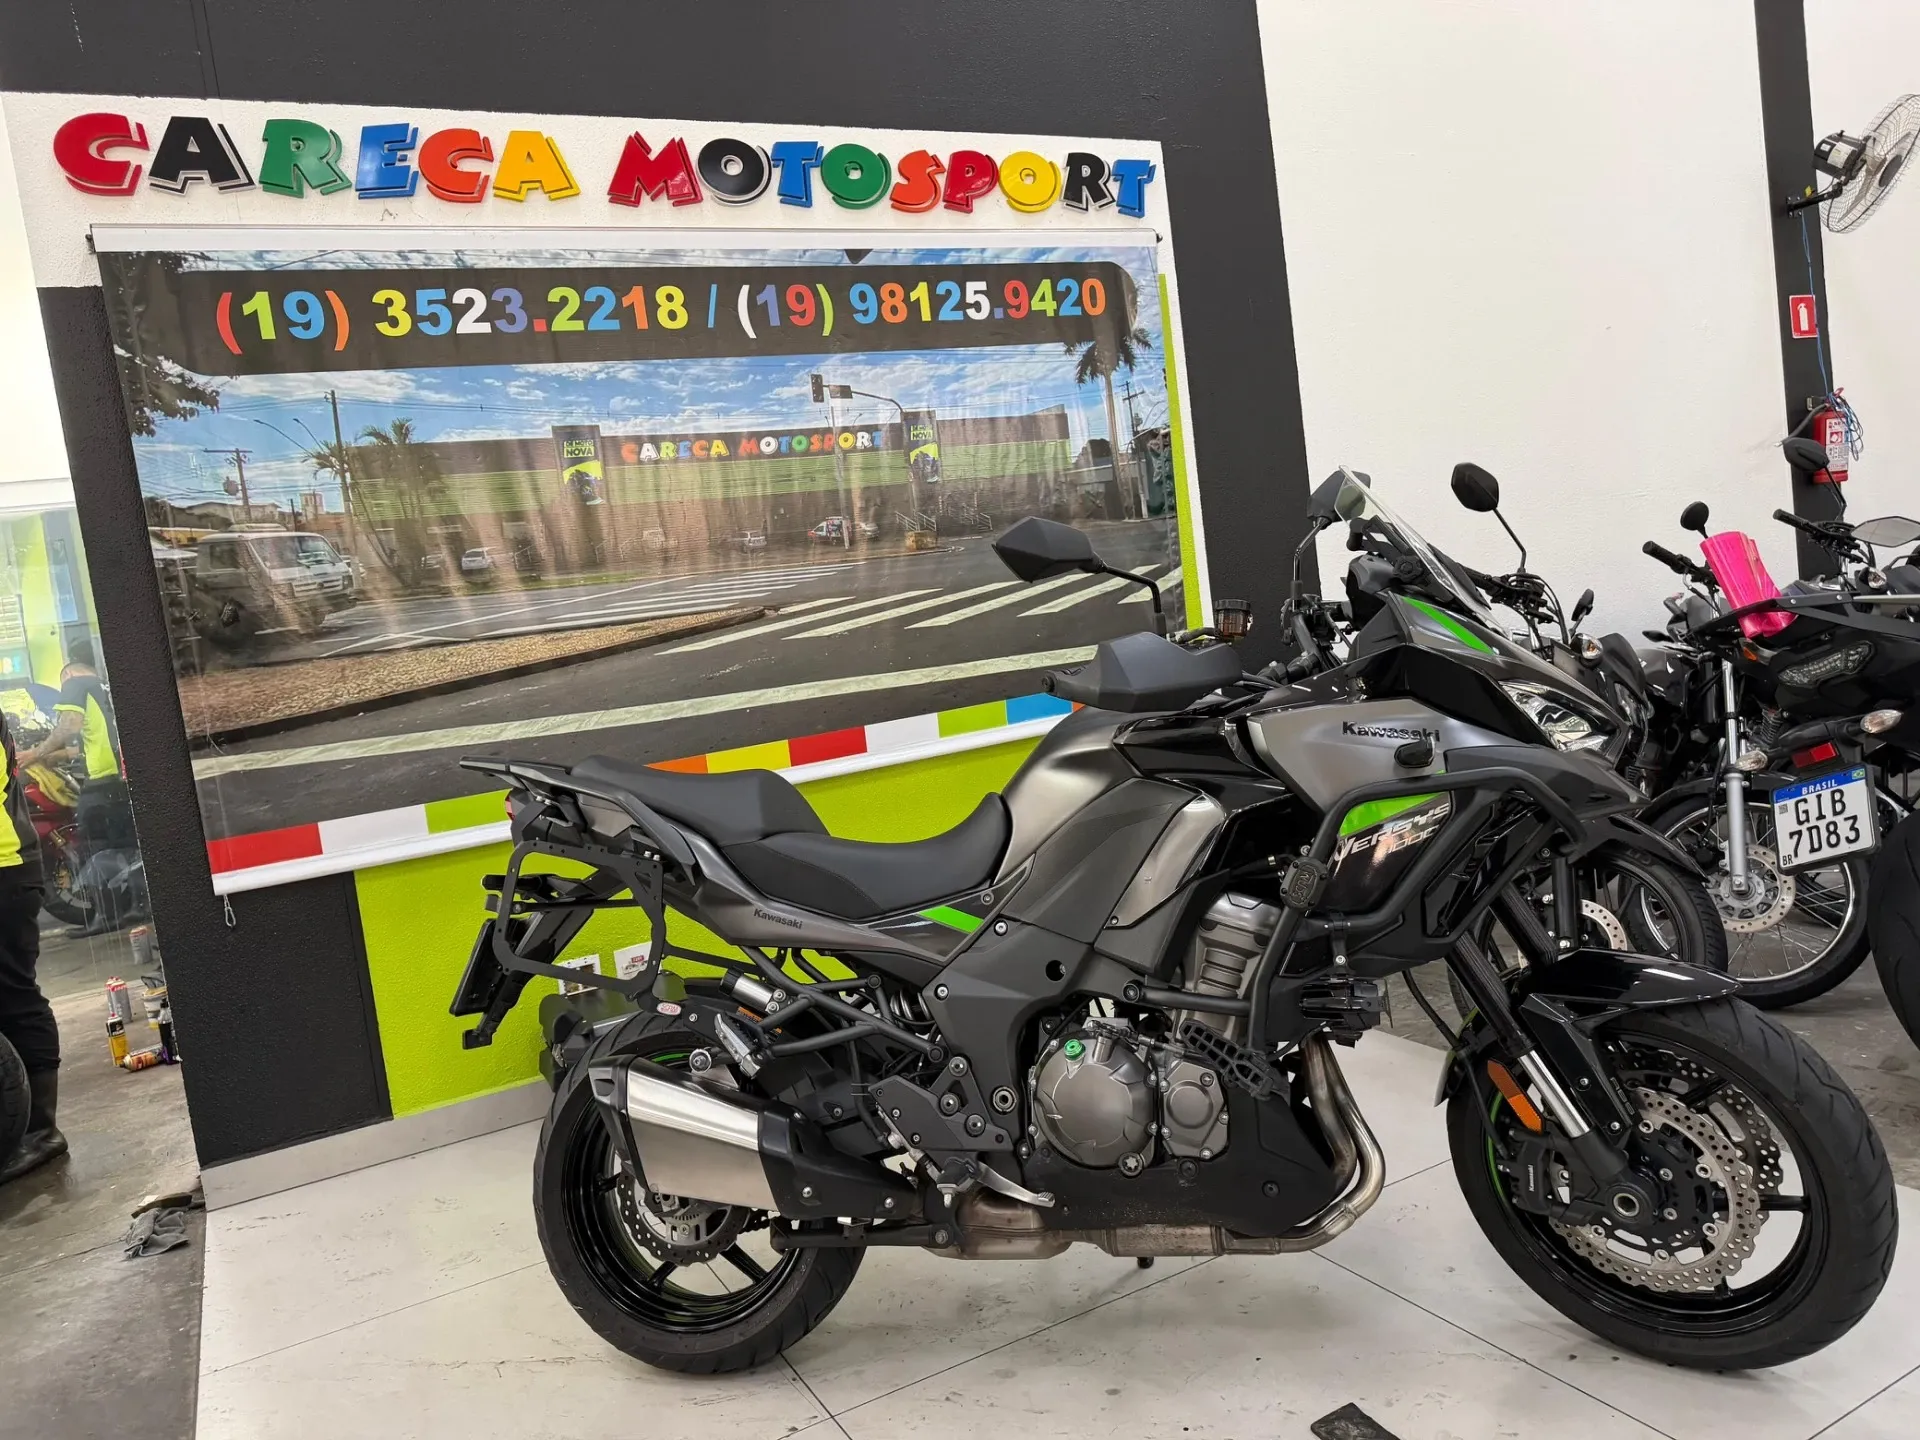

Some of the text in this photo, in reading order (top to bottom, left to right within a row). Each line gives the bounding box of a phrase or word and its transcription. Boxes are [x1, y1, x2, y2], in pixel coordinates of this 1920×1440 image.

[53, 112, 1156, 218] CARECA MOTOSPORT
[216, 290, 350, 355] (19)
[372, 285, 689, 337] 3523.2218
[737, 283, 834, 338] (19)
[849, 278, 1106, 325] 98125.9420
[566, 447, 593, 457] NOVA
[621, 431, 883, 463] CARECA MOTOSPORT
[1342, 721, 1441, 742] Kawasaki
[1801, 779, 1838, 796] BRASIL
[1794, 788, 1847, 826] GIB
[1788, 814, 1861, 858] 7D83
[1782, 854, 1794, 866] BR
[753, 908, 803, 930] Kawasaki
